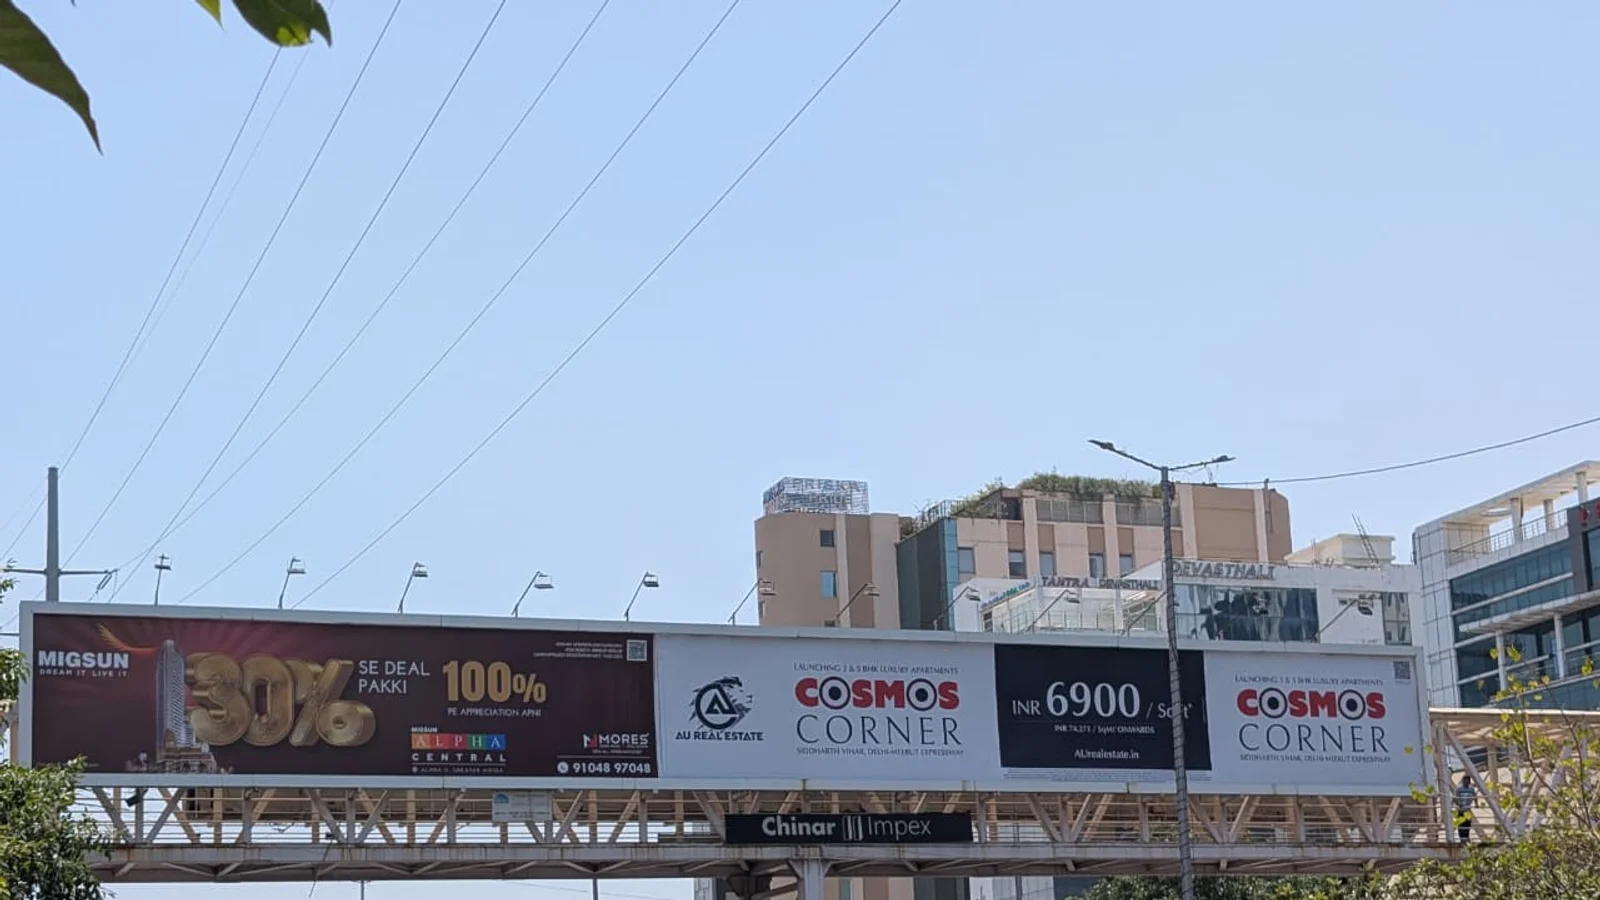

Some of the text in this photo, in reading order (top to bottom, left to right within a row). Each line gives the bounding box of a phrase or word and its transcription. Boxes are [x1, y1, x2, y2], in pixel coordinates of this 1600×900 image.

[1172, 560, 1276, 580] DEVASTHALI
[1042, 576, 1090, 588] TANTRA
[38, 650, 129, 669] MIGSUN
[40, 668, 73, 676] DREAM
[358, 660, 430, 676] SE DEAL
[793, 661, 841, 673] LAUNCHING
[910, 665, 959, 675] APARTMENTS
[358, 679, 407, 694] PAKKI
[443, 660, 547, 703] 100%
[186, 652, 376, 747] 30%
[795, 676, 960, 711] COSMOS
[1012, 700, 1041, 716] INR
[1046, 681, 1140, 718] 6900
[1237, 687, 1386, 720] COSMOS
[447, 707, 458, 716] PE
[460, 708, 519, 717] APPRECIATION
[675, 731, 764, 741] AU REAL ESTATE
[796, 714, 962, 745] CORNER
[414, 735, 501, 749] ALPHA
[598, 733, 650, 745] MORES
[1239, 723, 1389, 753] CORNER
[411, 752, 507, 763] CENTRAL
[573, 762, 651, 774] 91048 97048
[761, 815, 932, 841] Chinar Impex
